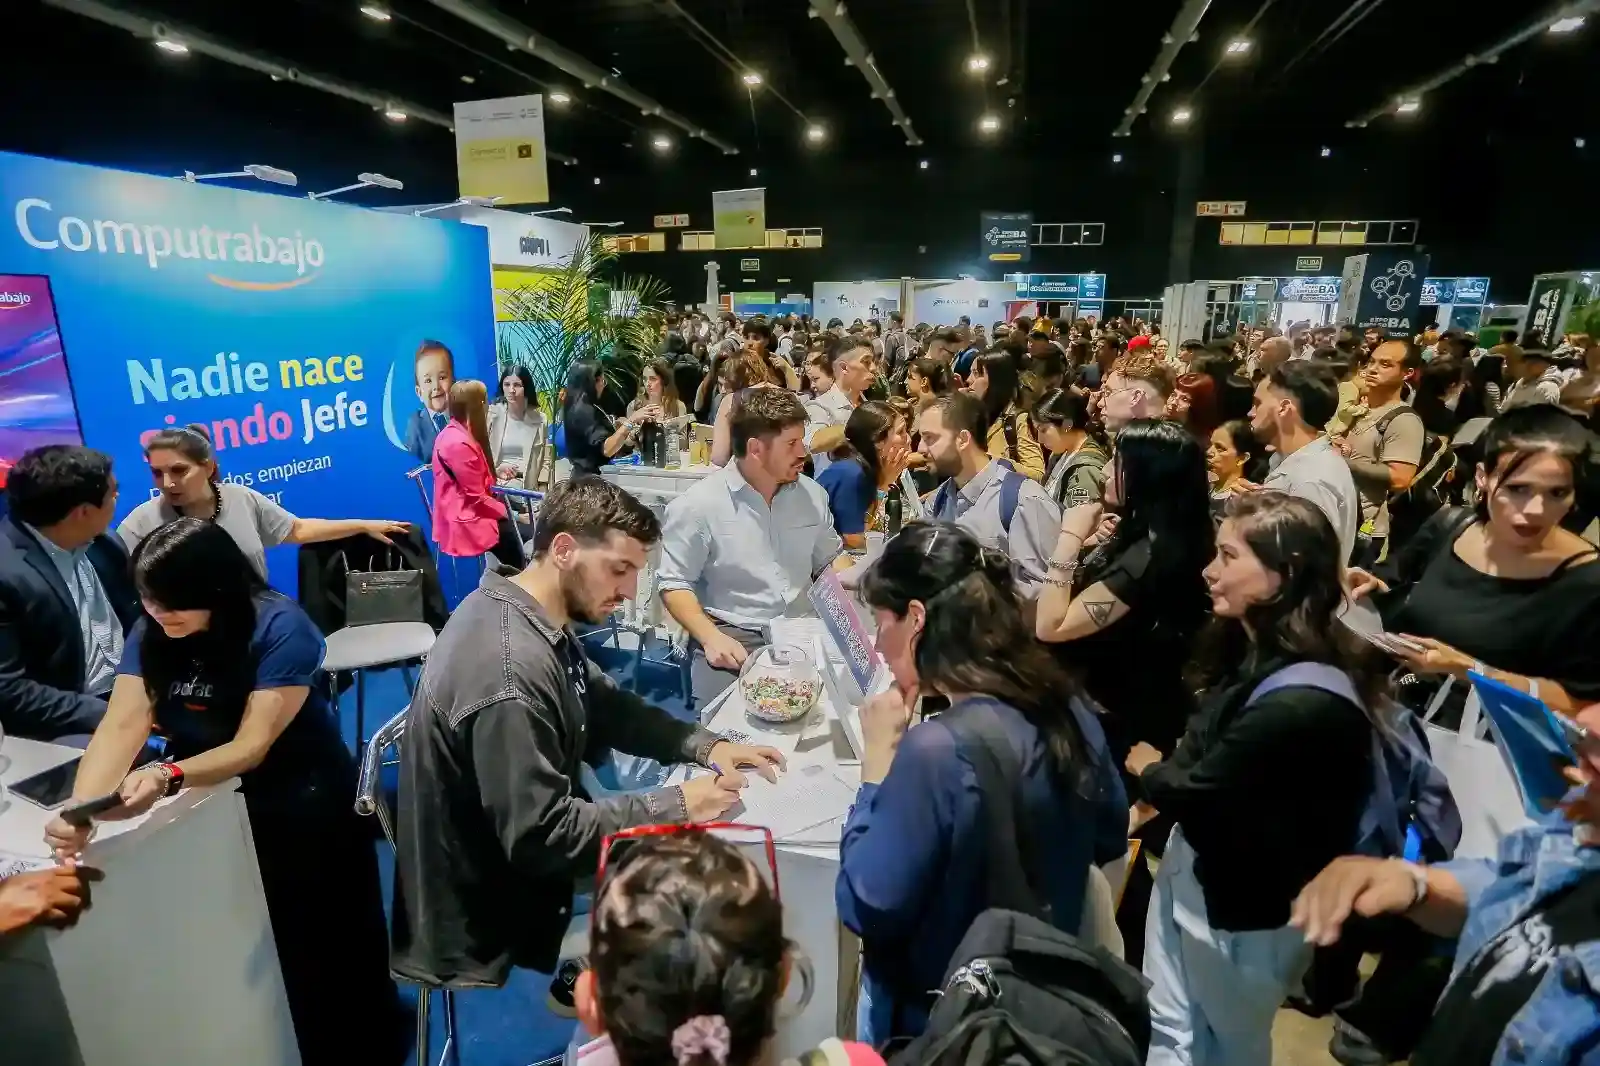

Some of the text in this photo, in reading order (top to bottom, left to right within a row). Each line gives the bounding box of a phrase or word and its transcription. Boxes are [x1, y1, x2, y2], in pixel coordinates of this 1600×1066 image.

[15, 198, 325, 275] Computrabajo
[1318, 285, 1336, 294] BA
[1533, 289, 1553, 326] BA
[1388, 317, 1410, 329] BA
[126, 352, 365, 405] Nadie nace
[301, 391, 368, 444] Jefe
[257, 455, 332, 486] empiezan
